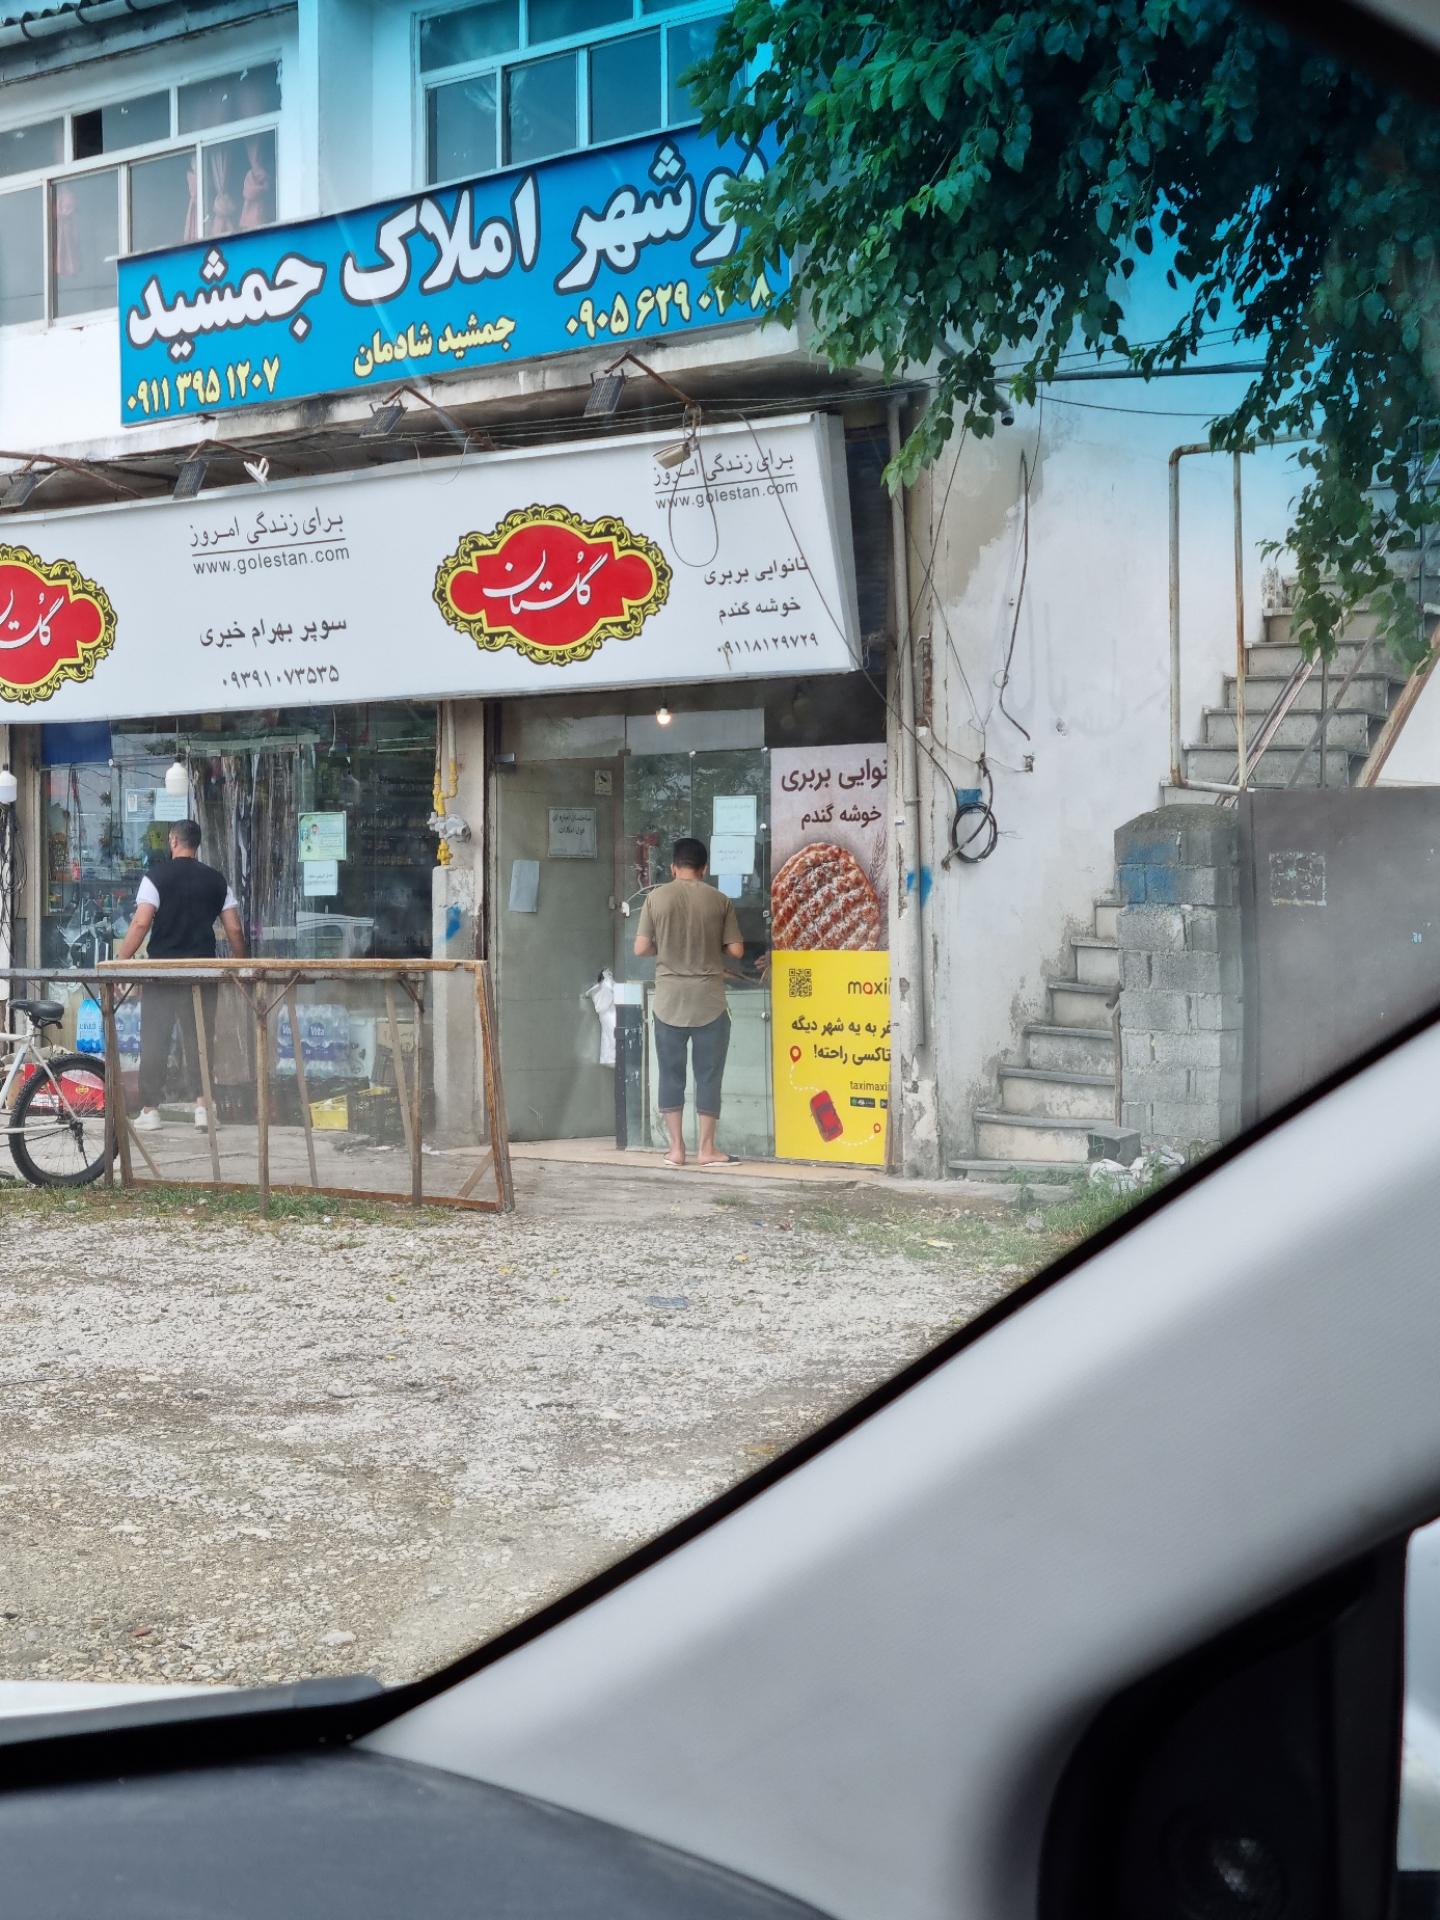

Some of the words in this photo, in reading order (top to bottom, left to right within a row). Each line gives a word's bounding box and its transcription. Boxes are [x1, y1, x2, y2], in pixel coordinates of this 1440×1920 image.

[339, 172, 541, 306] املاک
[126, 245, 327, 363] جمشید
[353, 321, 433, 377] شادمان
[438, 313, 516, 360] جمشید
[654, 459, 699, 487] امروز
[705, 452, 752, 481] زندگی
[756, 448, 793, 472] برای
[656, 481, 798, 509] www.golestan.com
[190, 516, 240, 547] امروز
[247, 511, 298, 544] زندگی
[303, 506, 344, 535] برای
[193, 547, 350, 574] www.golestan.com
[755, 556, 809, 582] نانوایی
[704, 568, 749, 585] بربری
[719, 601, 751, 625] گندم
[755, 596, 801, 617] خوشه
[200, 621, 246, 648] خیری
[252, 618, 294, 648] بهرام
[300, 618, 347, 642] سوپر
[222, 664, 339, 689] ۰۹۳۹۱۰۷۳۵۳۵
[781, 768, 831, 792] بربری
[800, 803, 834, 830] گندم
[840, 804, 882, 828] خوشه
[848, 977, 890, 995] maxi
[791, 1014, 817, 1034] دیگه
[821, 1017, 844, 1036] شهر
[865, 1022, 877, 1037] به
